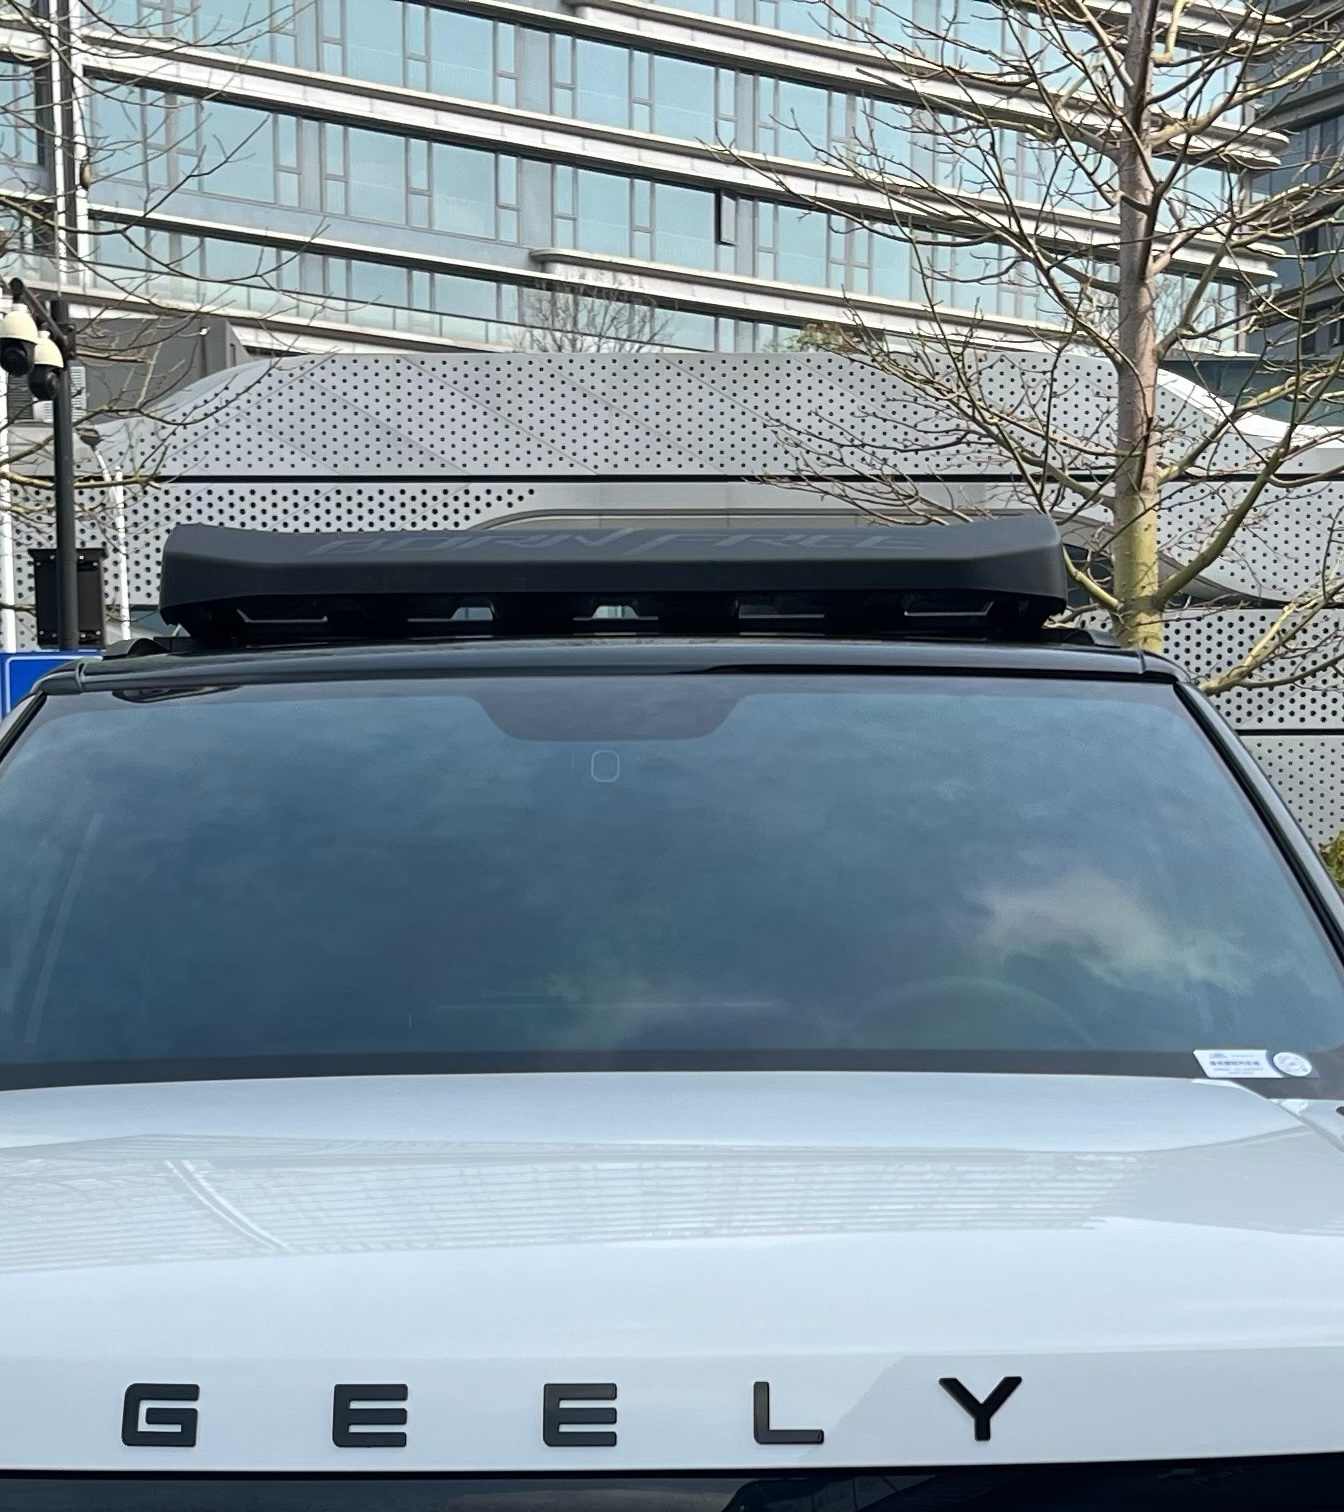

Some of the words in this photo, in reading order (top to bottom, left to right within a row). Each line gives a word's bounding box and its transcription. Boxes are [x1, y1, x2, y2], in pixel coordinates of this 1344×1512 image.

[304, 528, 646, 556] BORN
[623, 533, 927, 556] FREE
[121, 1375, 1023, 1448] GEELY
